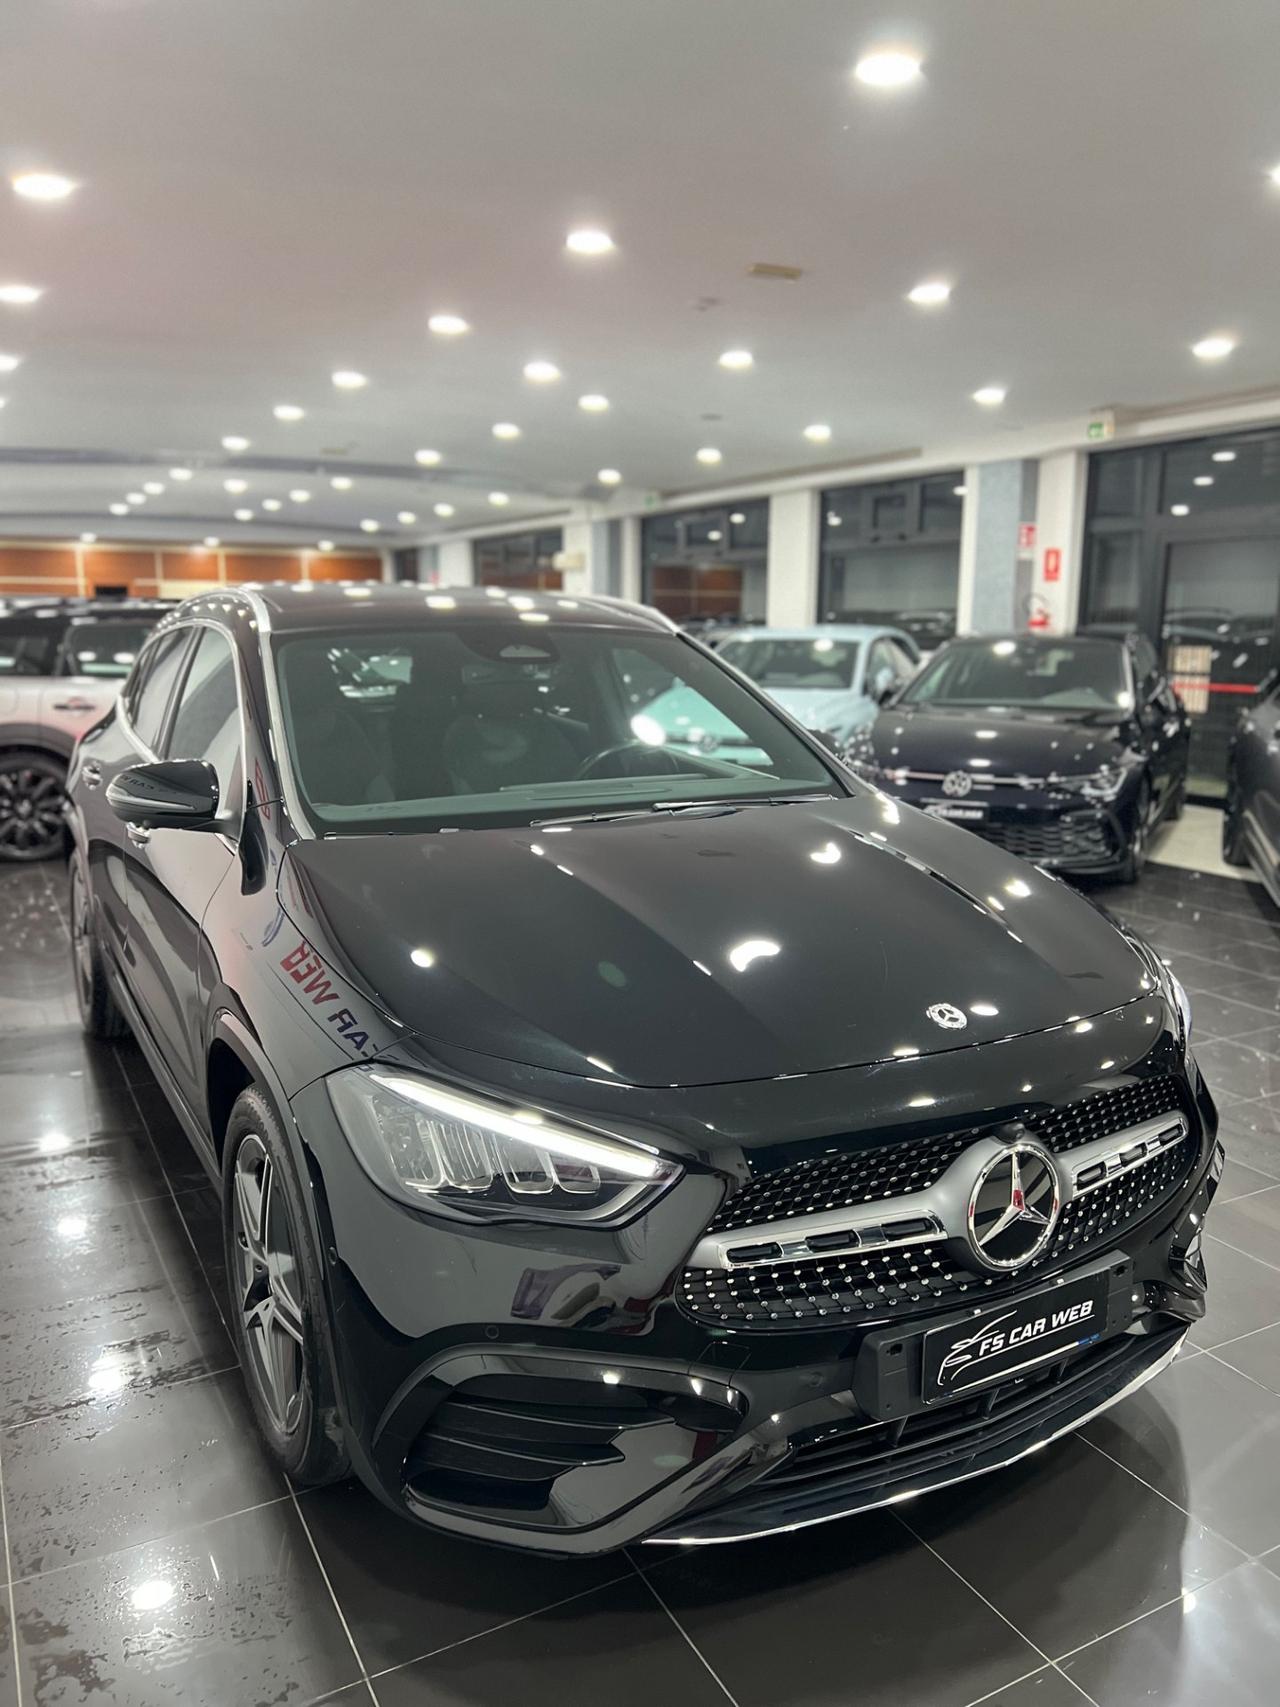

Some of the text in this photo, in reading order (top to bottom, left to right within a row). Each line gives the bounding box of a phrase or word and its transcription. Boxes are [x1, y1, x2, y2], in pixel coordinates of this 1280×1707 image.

[978, 1299, 1094, 1357] FS CAR WEB
